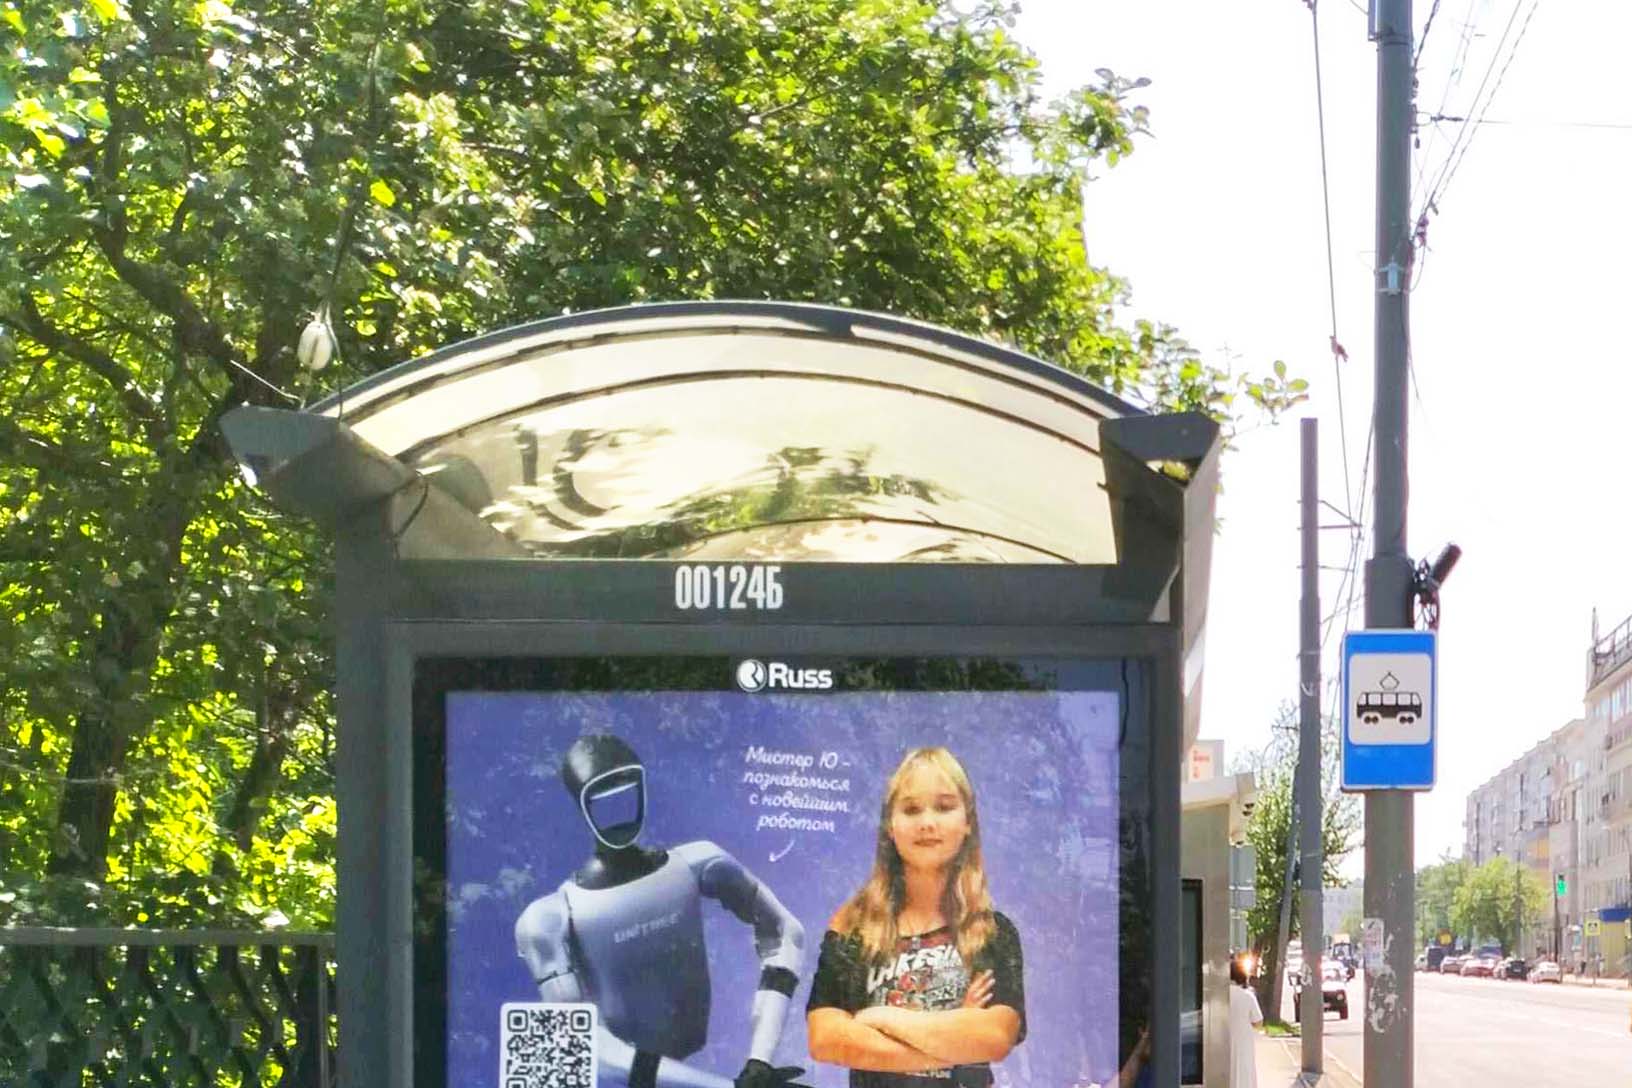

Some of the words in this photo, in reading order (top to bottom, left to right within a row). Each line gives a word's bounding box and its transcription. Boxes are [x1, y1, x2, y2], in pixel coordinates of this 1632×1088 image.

[768, 662, 833, 689] Russ
[745, 746, 814, 772] Мистер
[744, 771, 850, 791] познакомься
[749, 794, 758, 805] с
[762, 791, 848, 812] новейшим
[756, 812, 835, 832] роботом
